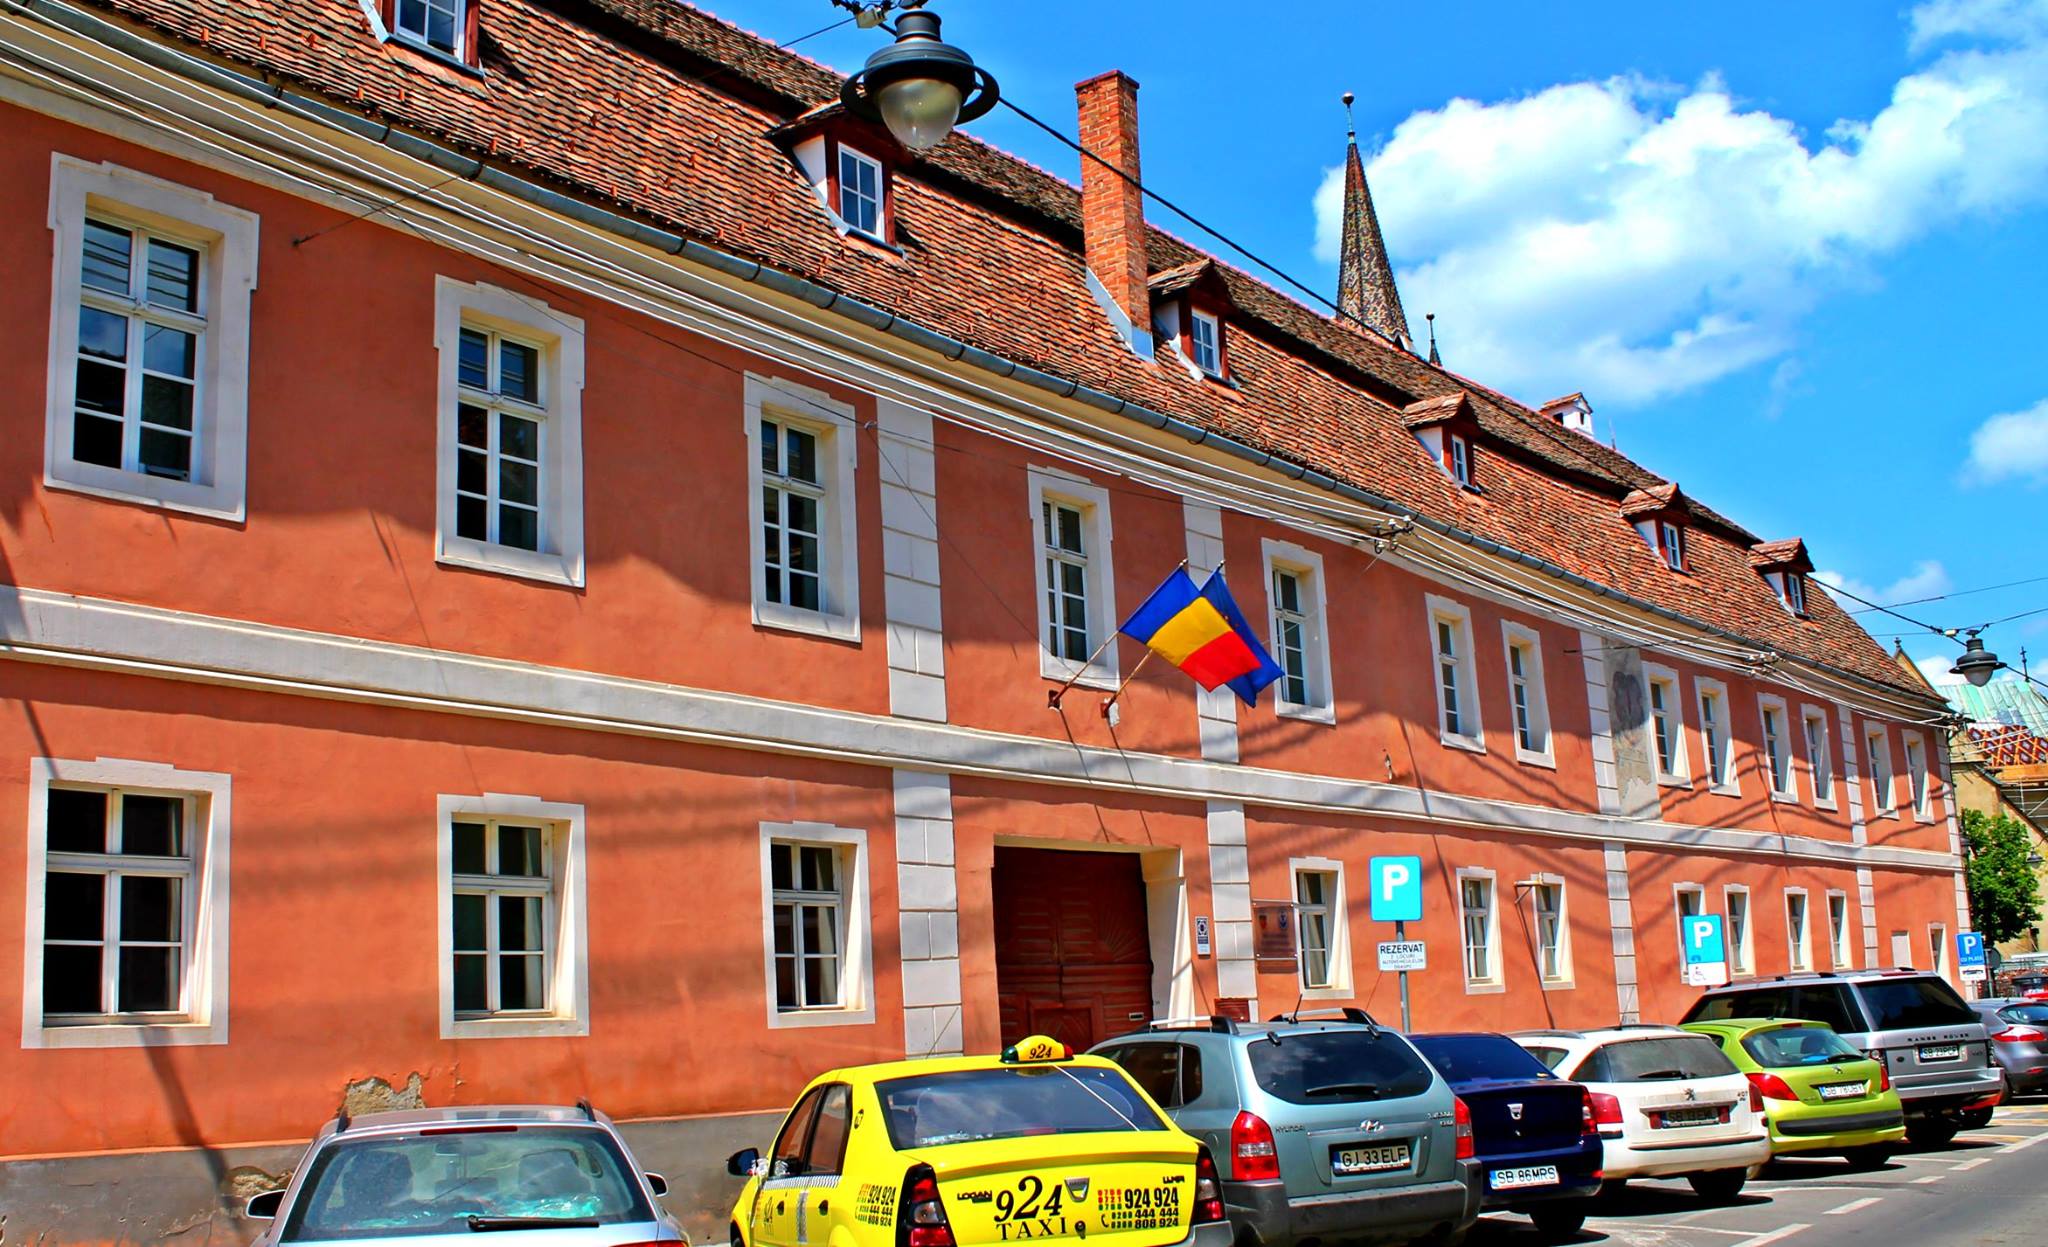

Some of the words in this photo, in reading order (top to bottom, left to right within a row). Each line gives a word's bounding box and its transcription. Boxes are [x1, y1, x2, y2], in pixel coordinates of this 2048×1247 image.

[1382, 864, 1409, 901] P
[1693, 921, 1714, 948] P
[1380, 943, 1424, 954] REZERVAT
[1963, 936, 1977, 954] P
[1029, 1043, 1052, 1059] 924
[1341, 1152, 1360, 1167] GJ
[1497, 1171, 1514, 1184] SB
[868, 1184, 882, 1204] 924
[881, 1186, 896, 1205] 924
[957, 1190, 992, 1201] LOGAN
[994, 1175, 1062, 1222] 924
[1125, 1188, 1151, 1209] 924
[1154, 1187, 1179, 1207] 924
[1135, 1208, 1155, 1218] 444
[1159, 1207, 1178, 1217] 444
[996, 1217, 1067, 1240] TAXI
[1135, 1219, 1156, 1229] 808
[1159, 1217, 1179, 1227] 924
